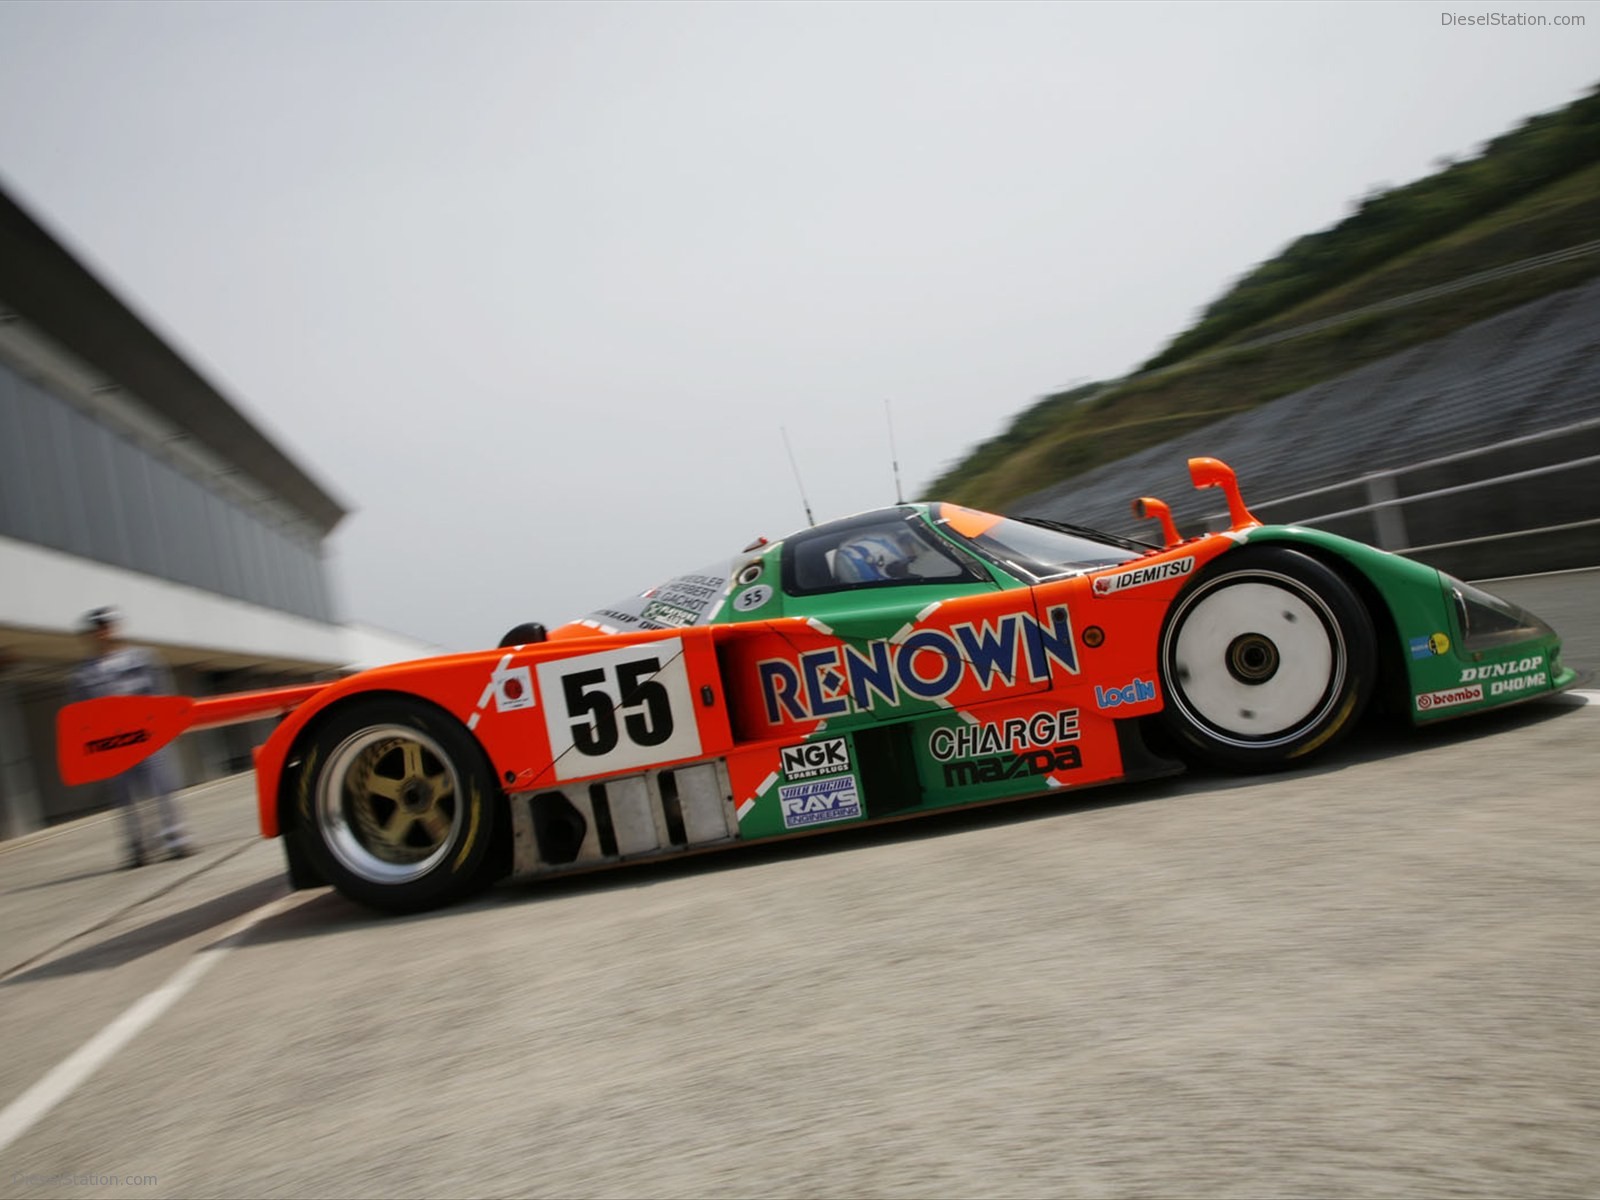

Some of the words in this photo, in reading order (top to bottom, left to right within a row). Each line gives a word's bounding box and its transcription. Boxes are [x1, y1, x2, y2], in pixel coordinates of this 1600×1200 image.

[1116, 558, 1193, 589] IDEMITSU
[743, 589, 763, 607] 55
[757, 603, 1081, 726] RENOWN
[1459, 656, 1543, 683] DUNLOP
[561, 656, 674, 757] 55
[1433, 688, 1481, 706] brembo
[928, 708, 1081, 762] CHARGE
[783, 740, 846, 772] NGK
[787, 770, 818, 781] SPARK
[819, 763, 849, 775] PLUGS
[783, 791, 857, 817] RAYS
